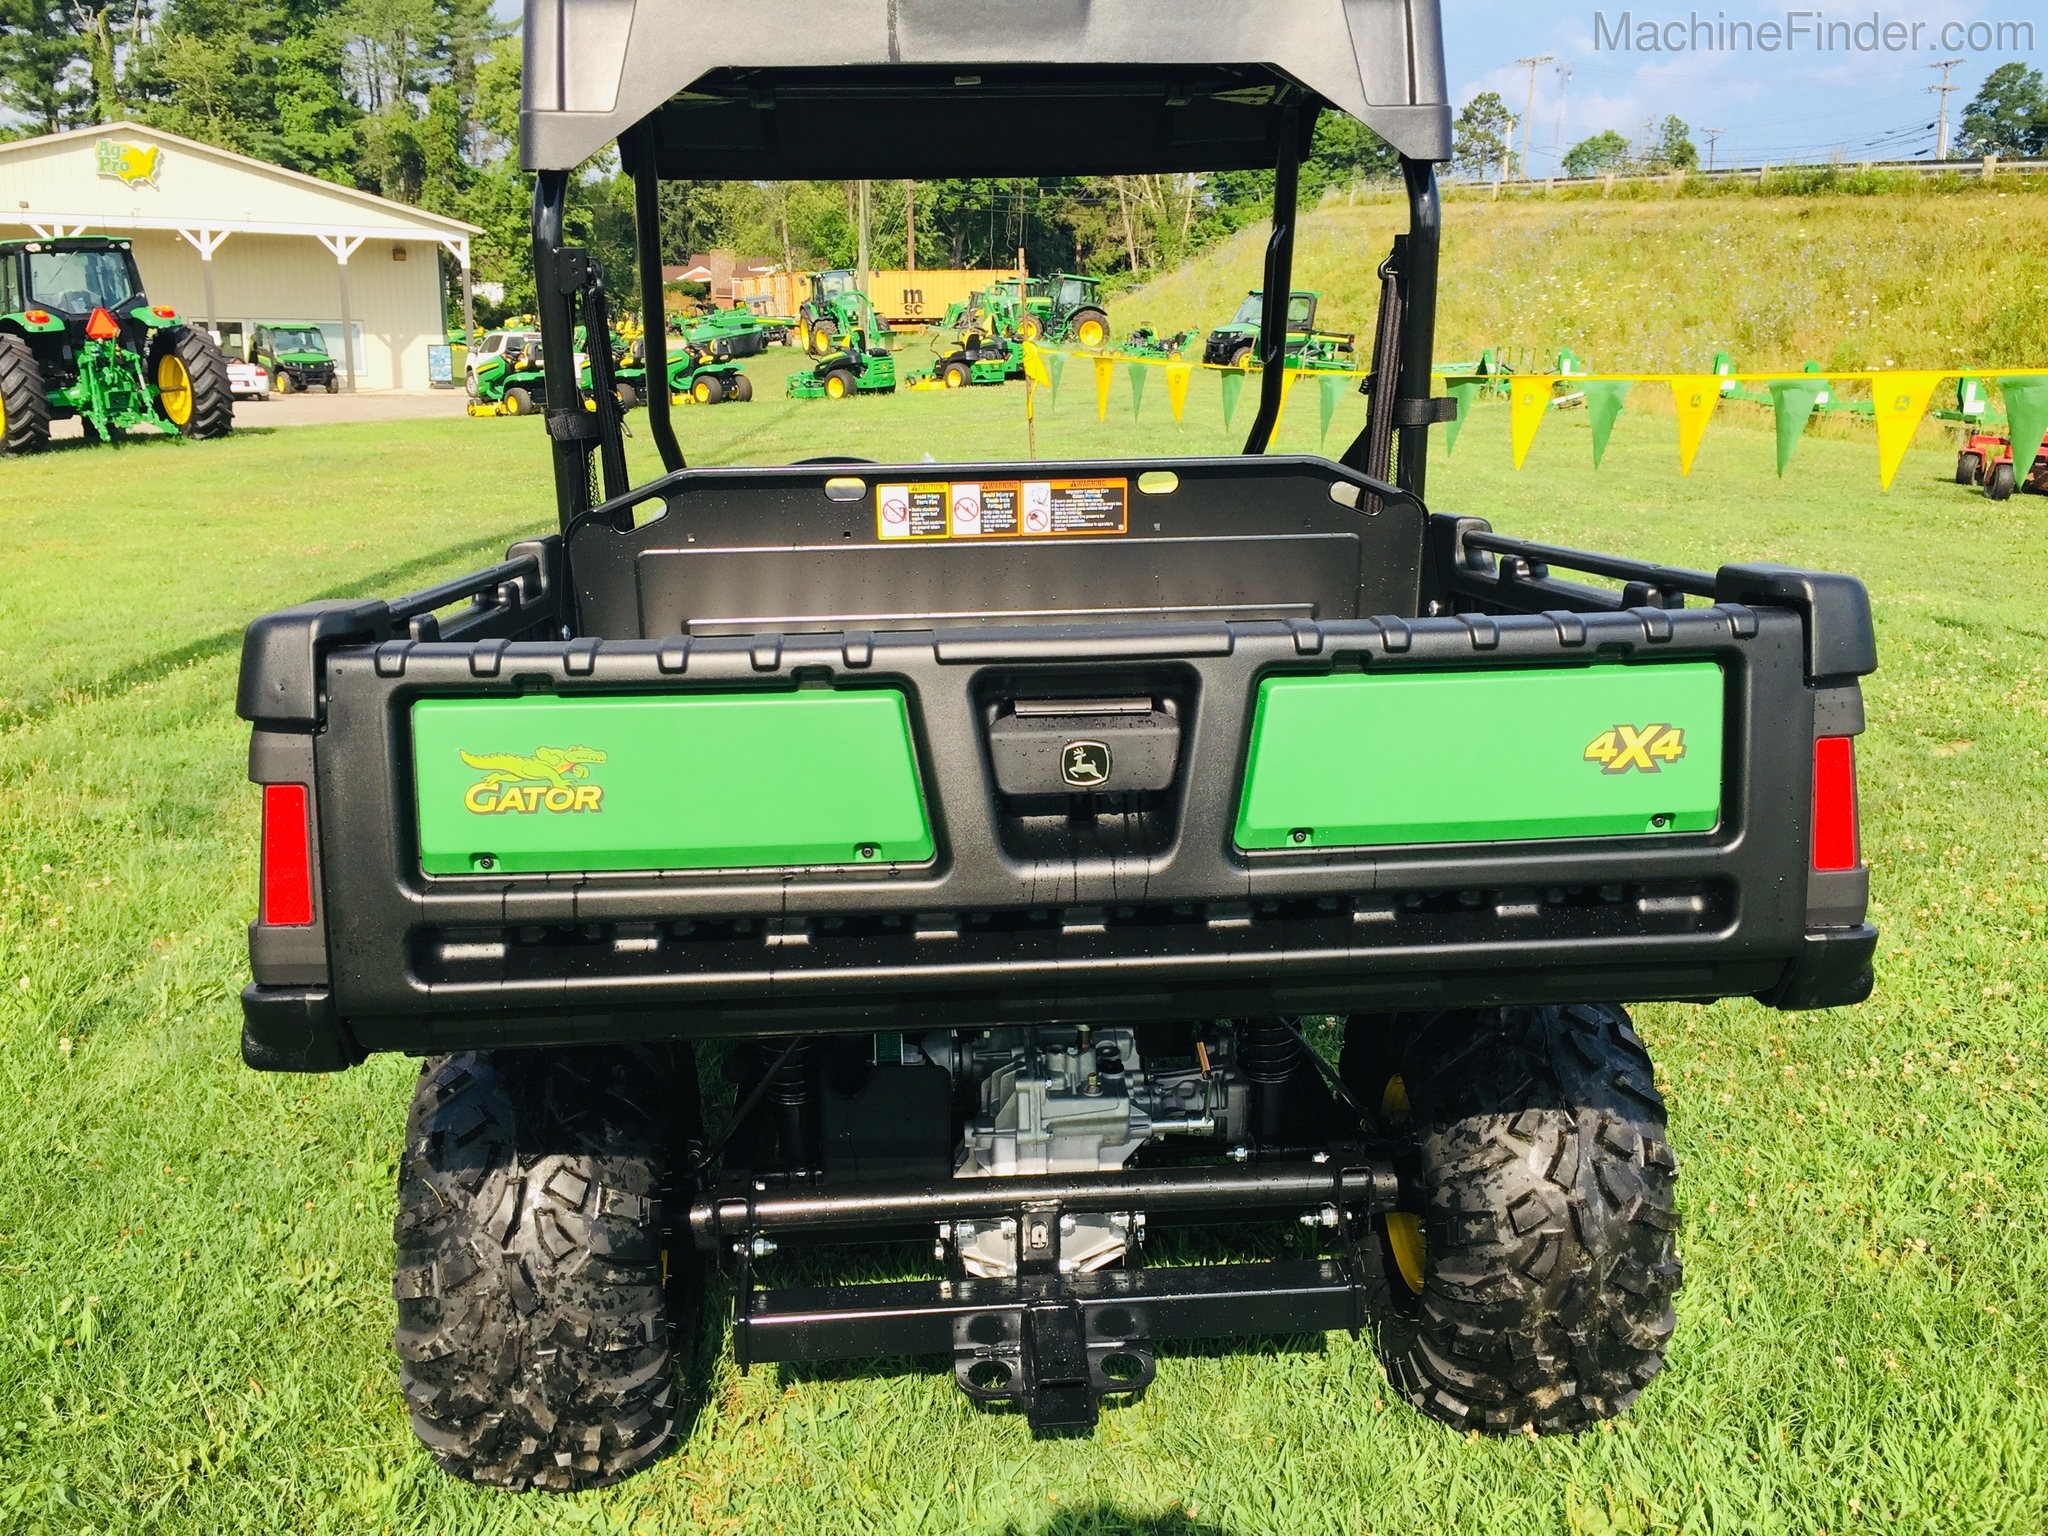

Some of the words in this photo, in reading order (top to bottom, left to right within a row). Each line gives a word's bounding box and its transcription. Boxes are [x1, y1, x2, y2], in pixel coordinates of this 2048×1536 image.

[98, 141, 128, 159] Ag-
[99, 157, 130, 171] Pro
[464, 782, 604, 815] GATOR
